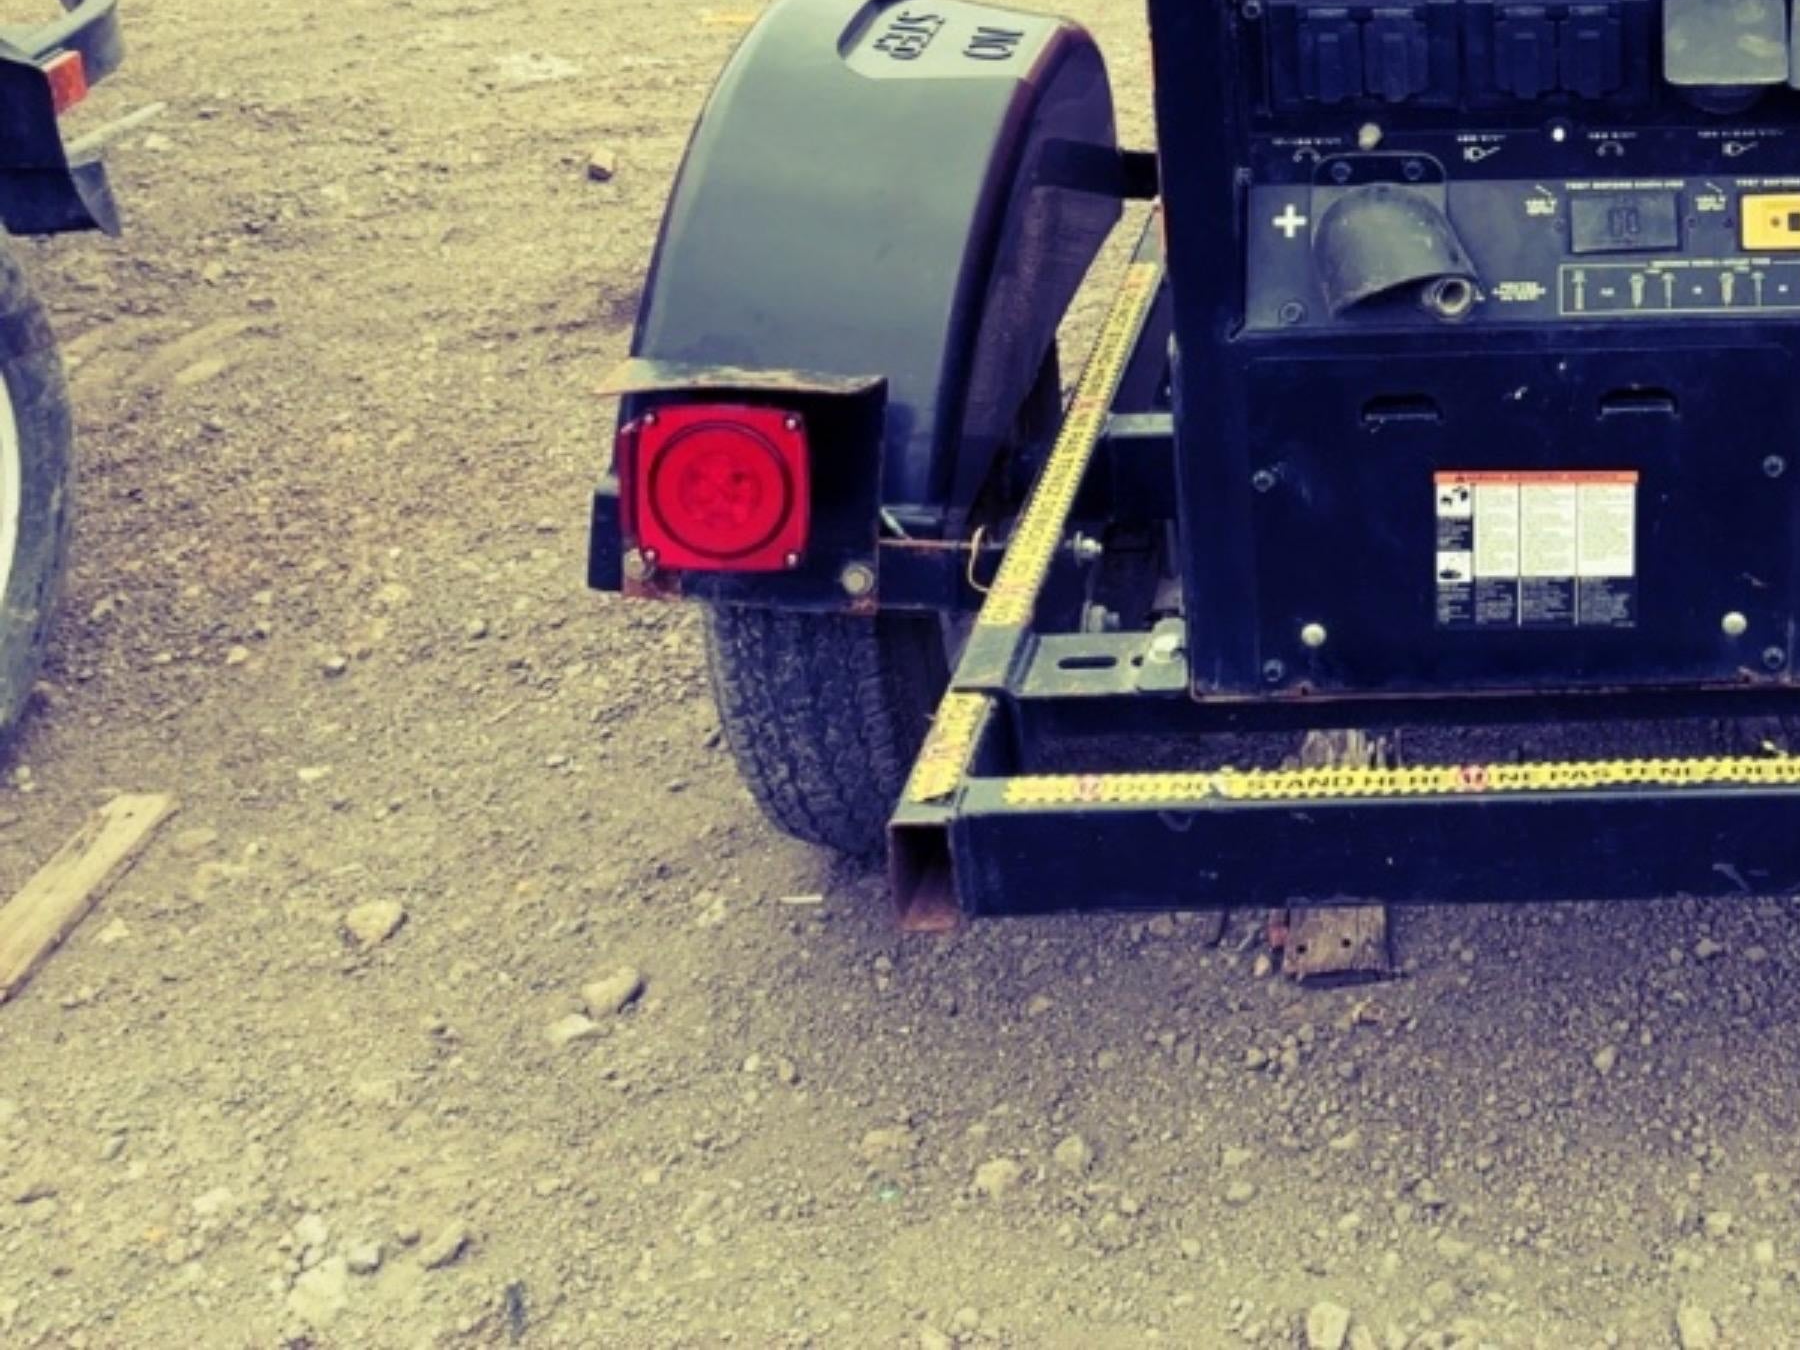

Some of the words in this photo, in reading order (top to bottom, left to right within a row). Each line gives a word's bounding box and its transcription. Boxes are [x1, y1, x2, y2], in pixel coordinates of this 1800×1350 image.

[872, 9, 946, 60] STEP
[963, 26, 1025, 60] NO
[1246, 774, 1354, 792] STAND
[1363, 772, 1444, 789] HERE
[1498, 769, 1533, 784] NE
[1549, 767, 1609, 782] PAS
[1621, 765, 1719, 779] TENEZ
